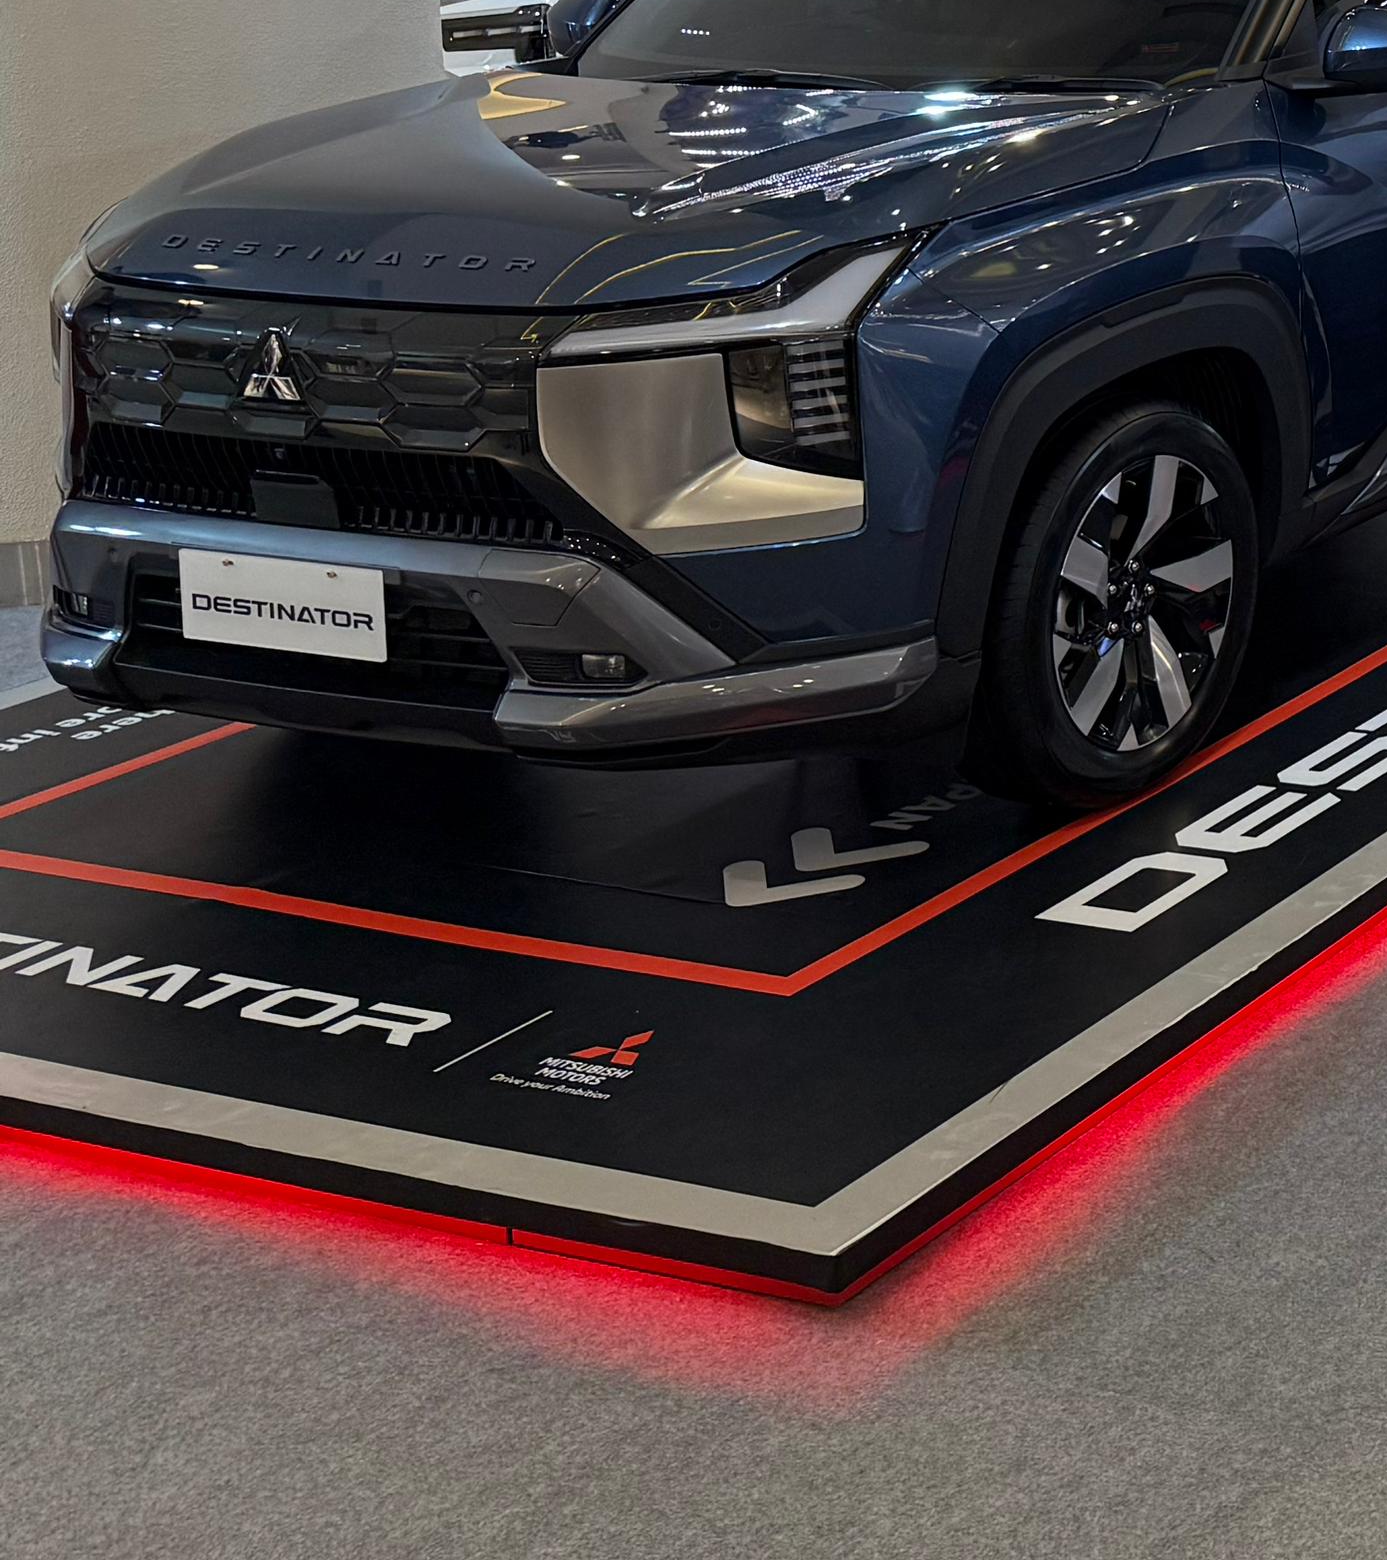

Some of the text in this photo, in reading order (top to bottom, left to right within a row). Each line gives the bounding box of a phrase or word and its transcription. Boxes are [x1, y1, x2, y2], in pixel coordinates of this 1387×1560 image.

[160, 233, 536, 273] DESTINATOR
[191, 592, 374, 632] DESTINATOR
[0, 706, 122, 752] ore inf
[534, 1067, 607, 1086] MOTORS
[538, 1056, 634, 1079] MITSUBISHI
[489, 1073, 612, 1101] Drive your Ambition
